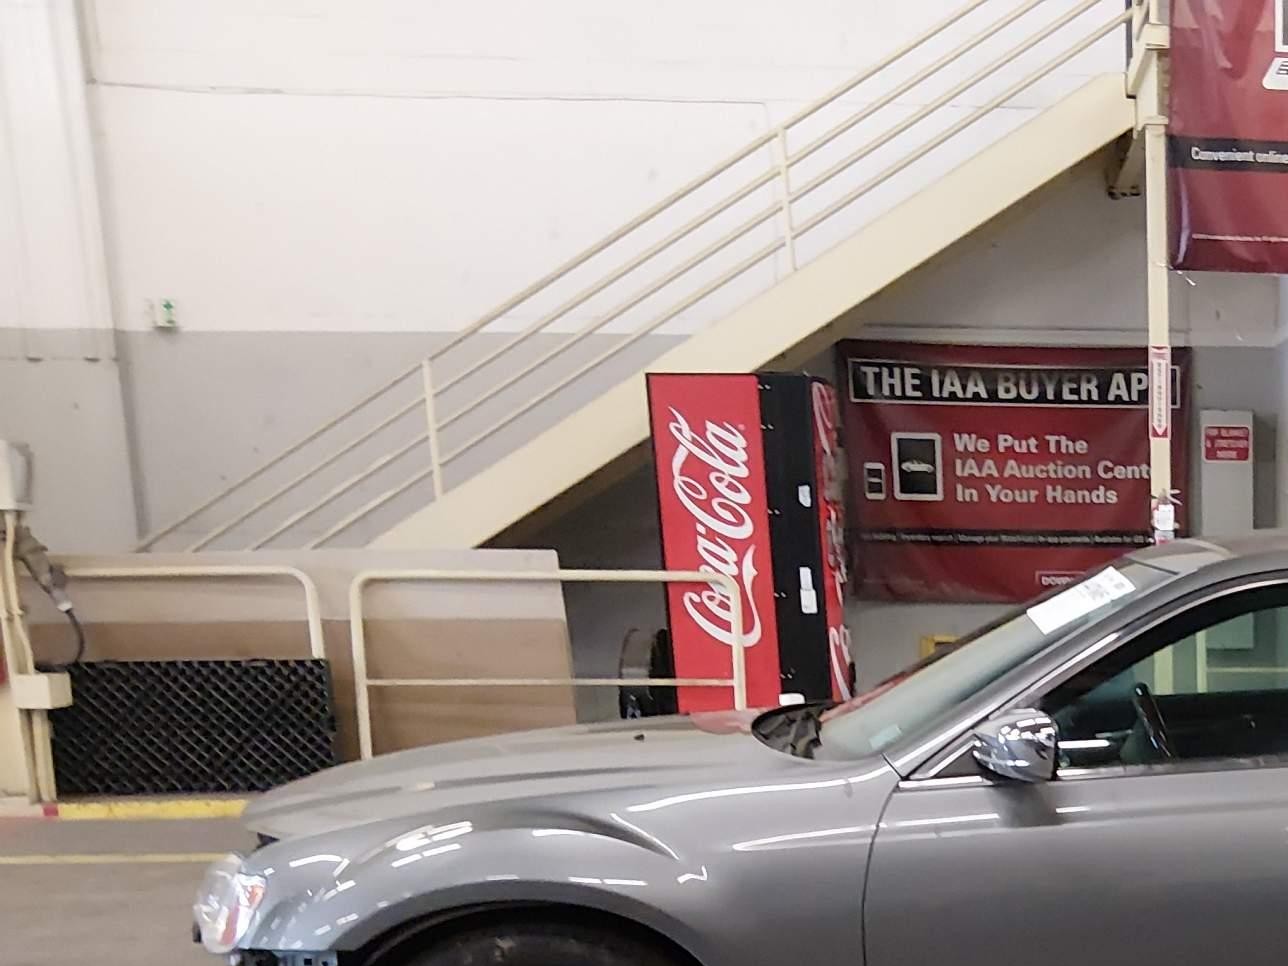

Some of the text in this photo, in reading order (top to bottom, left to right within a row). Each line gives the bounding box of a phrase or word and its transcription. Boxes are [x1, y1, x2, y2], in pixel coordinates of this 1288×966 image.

[860, 366, 923, 397] THE
[931, 368, 989, 399] IAA
[997, 371, 1099, 401] BUYER
[1107, 372, 1149, 402] AP
[953, 432, 1088, 454] We Put The
[955, 458, 1150, 479] IAA Auction Cent
[956, 483, 1118, 503] In Your Hands
